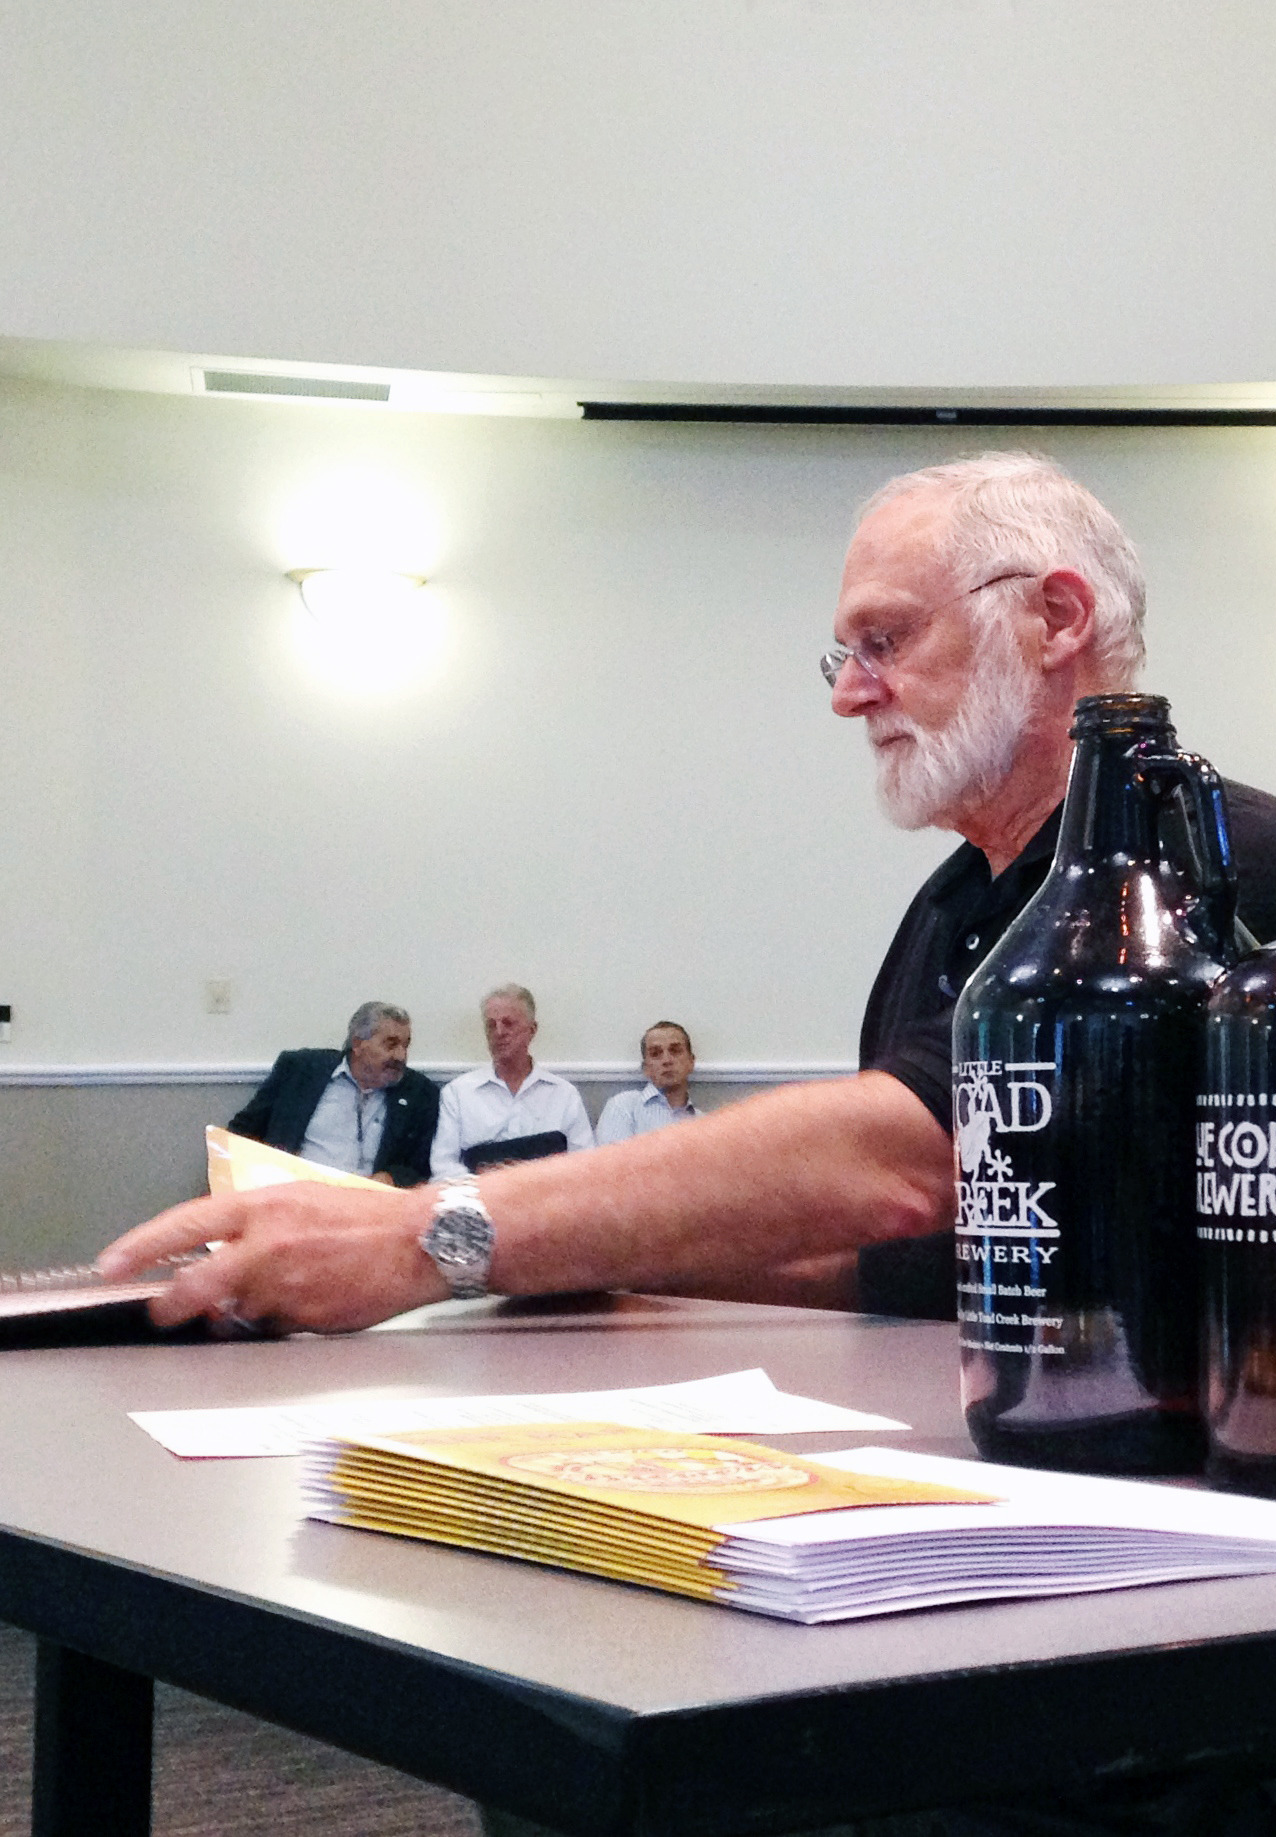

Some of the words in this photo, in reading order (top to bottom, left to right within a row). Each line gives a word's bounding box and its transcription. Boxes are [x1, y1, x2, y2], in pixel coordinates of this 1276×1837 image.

[958, 1061, 1003, 1077] LITTLE
[954, 1082, 1053, 1133] OAD
[954, 1182, 1059, 1228] REEK
[955, 1242, 1059, 1264] REWERY
